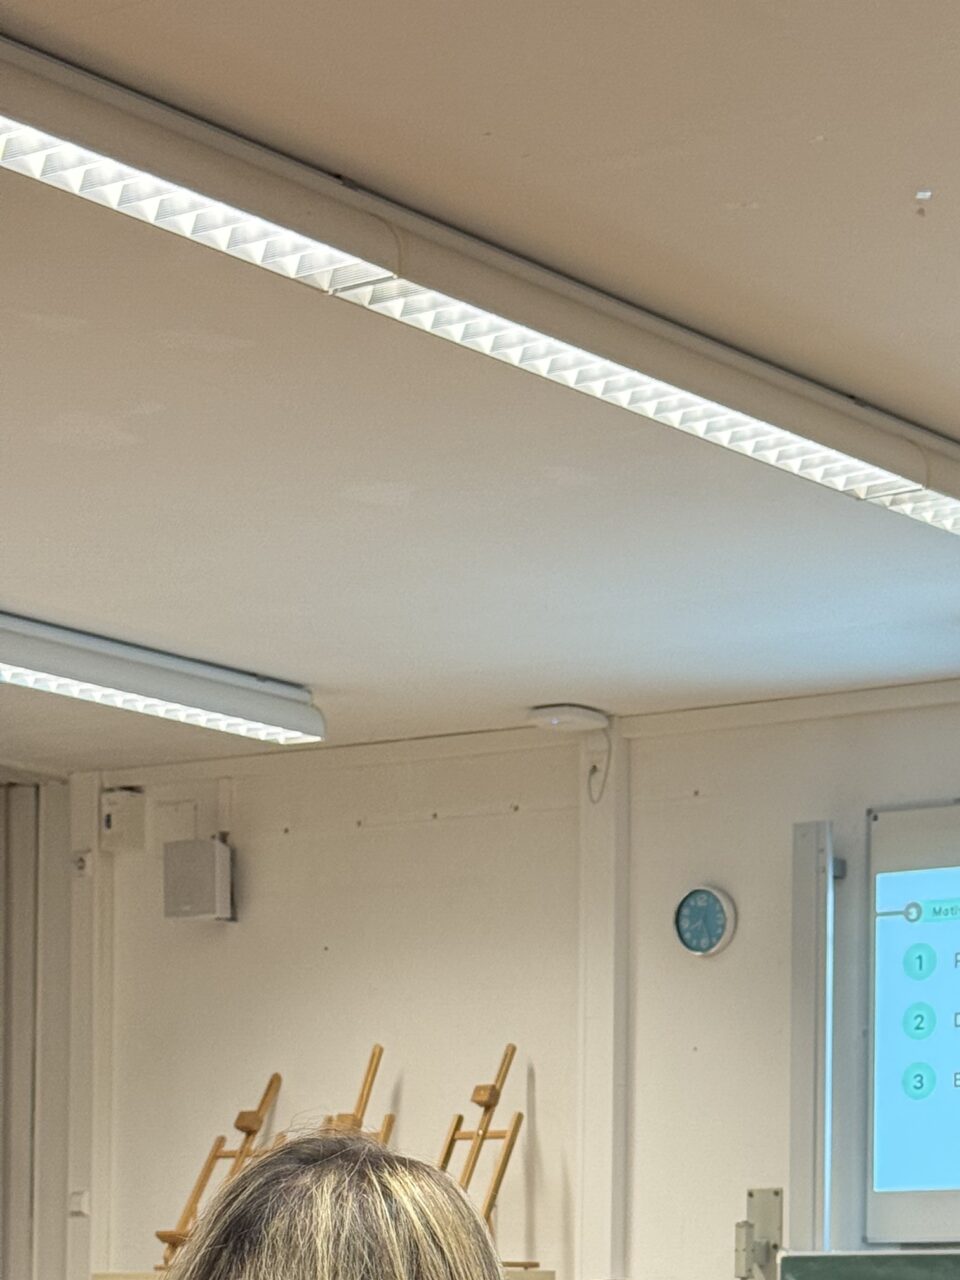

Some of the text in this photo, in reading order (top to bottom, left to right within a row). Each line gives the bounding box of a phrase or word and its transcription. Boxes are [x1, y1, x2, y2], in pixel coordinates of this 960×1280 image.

[915, 954, 924, 971] 1
[913, 1013, 926, 1031] 2
[912, 1073, 925, 1091] 3
